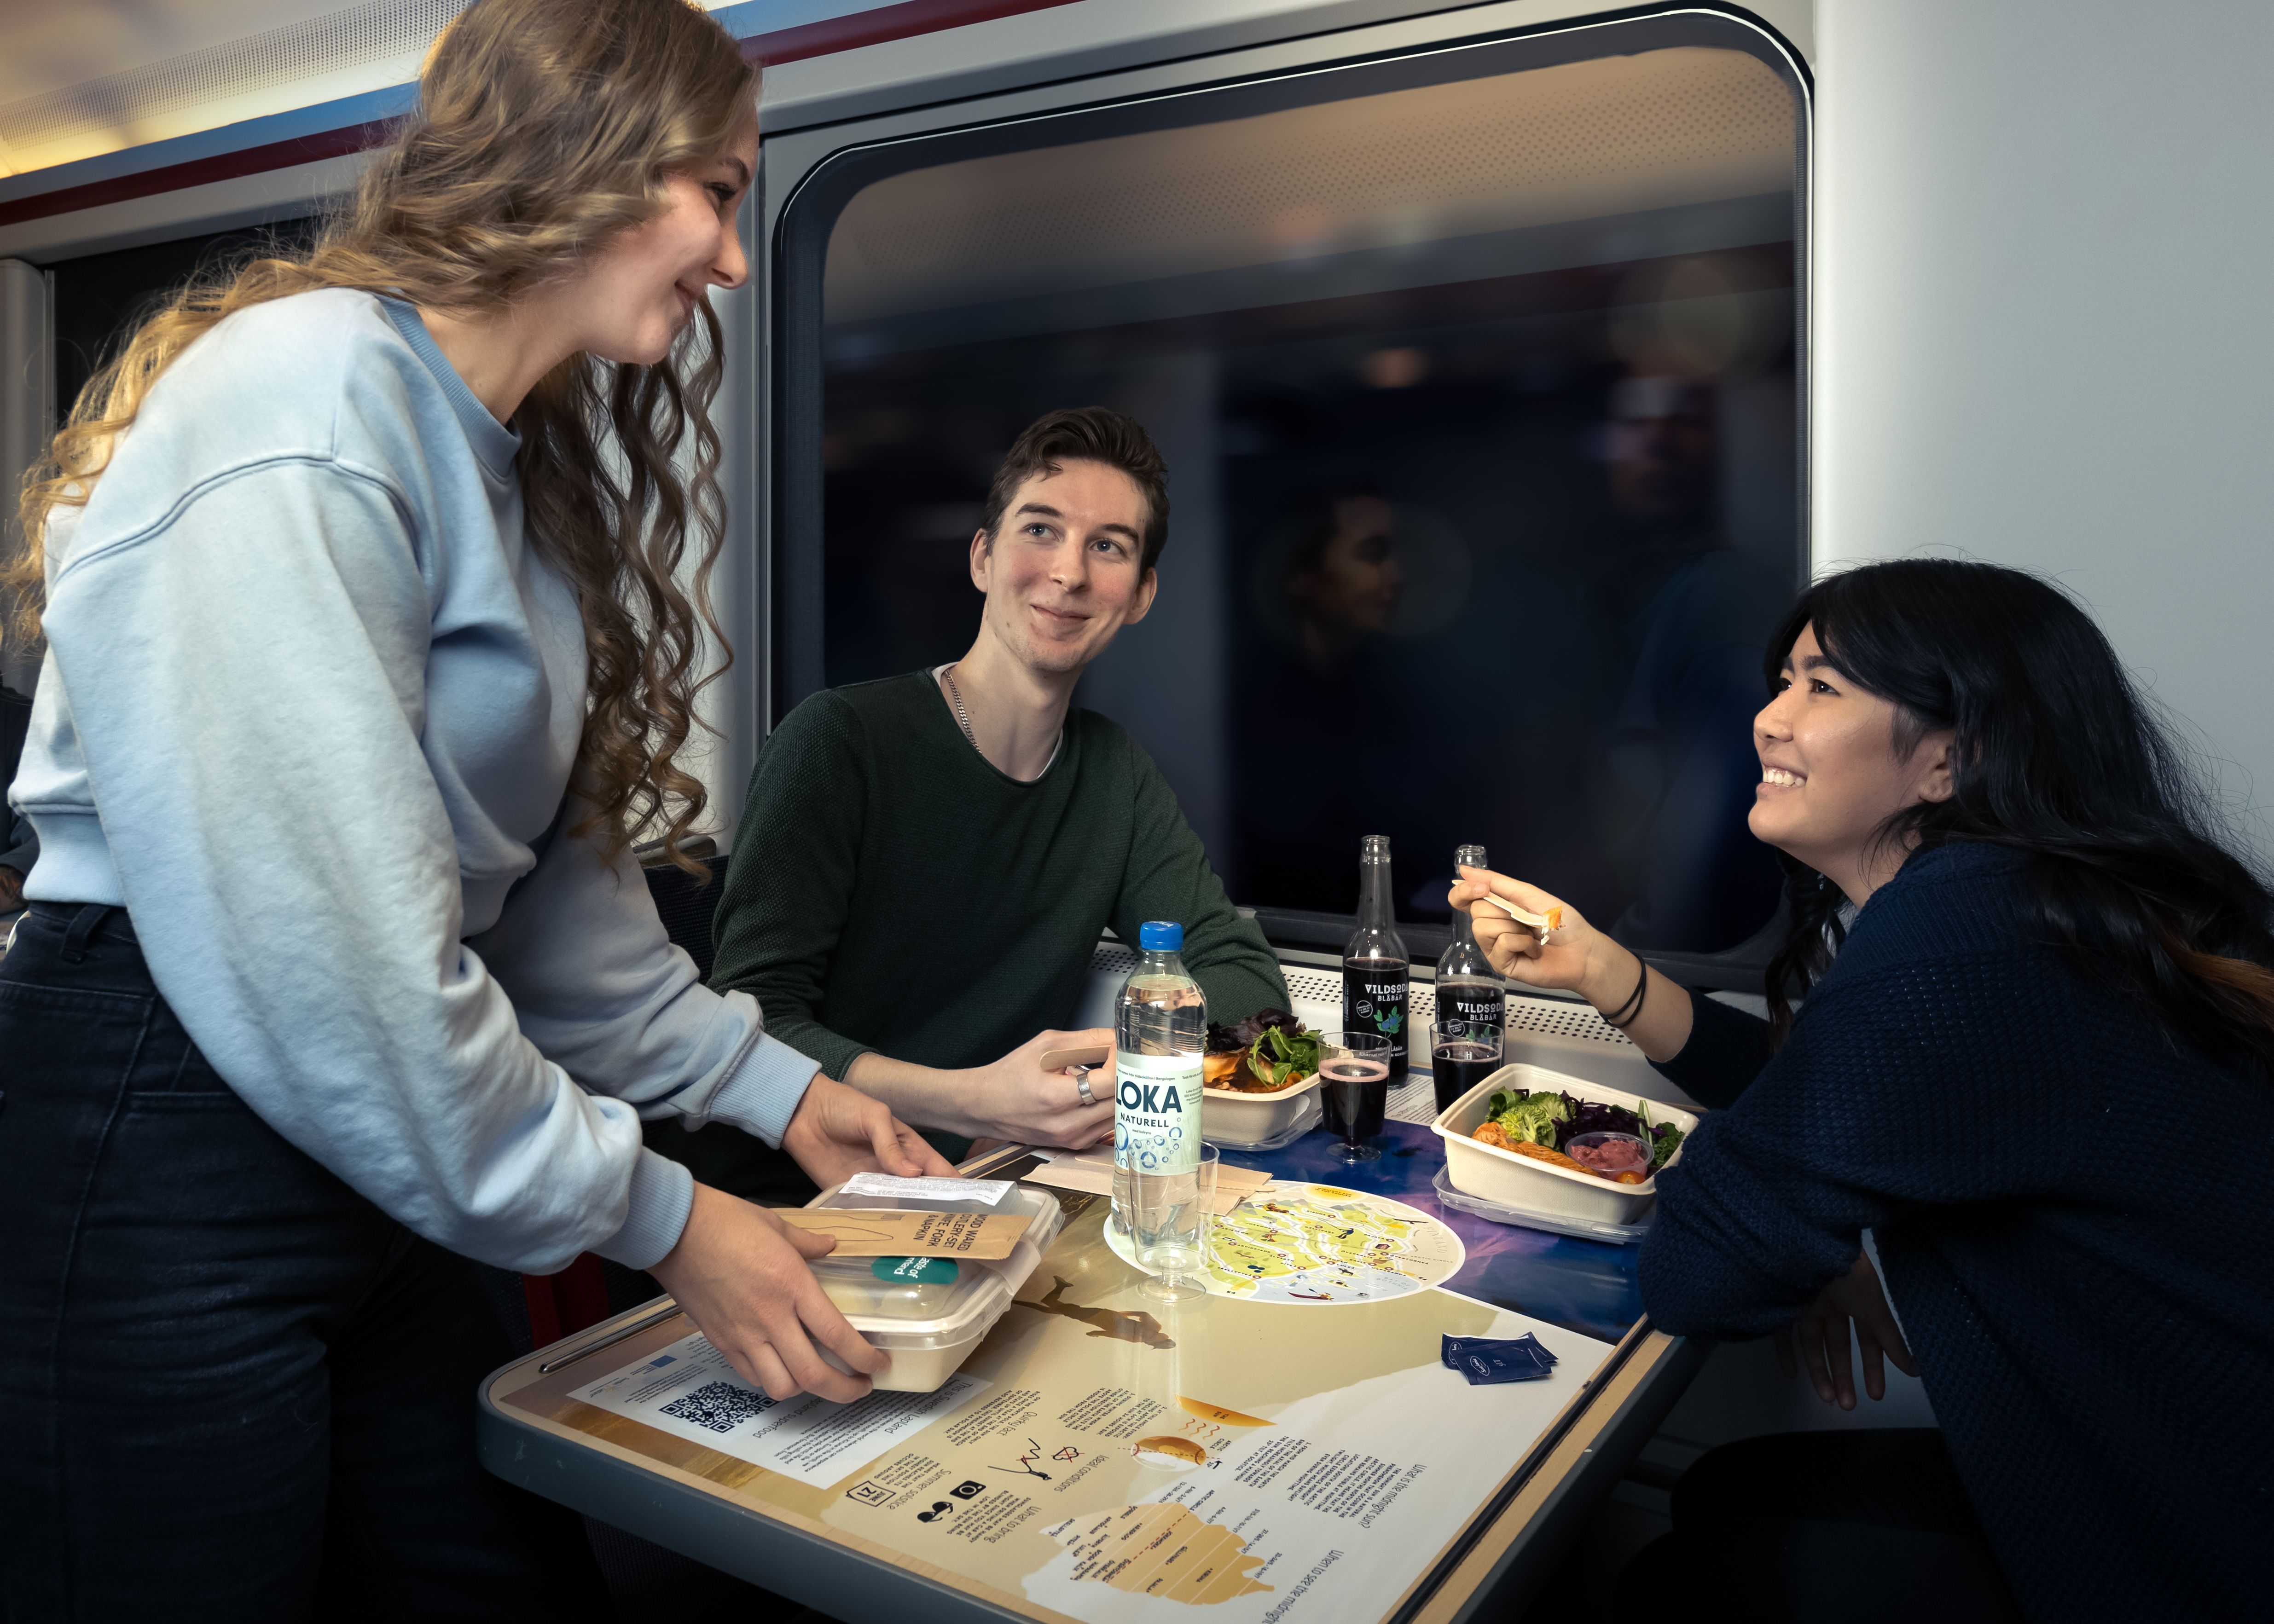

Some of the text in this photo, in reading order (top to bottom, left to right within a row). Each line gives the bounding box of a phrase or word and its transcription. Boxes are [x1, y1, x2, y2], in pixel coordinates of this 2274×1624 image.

[1365, 982, 1408, 994] VILDSODA
[1456, 1002, 1504, 1013] VILDSODA
[1116, 1075, 1182, 1114] LOKA
[1120, 1112, 1169, 1127] NATURELL
[970, 1214, 988, 1228] WOOD
[913, 1219, 936, 1240] NAPKIN
[943, 1214, 972, 1248] CUTLERY-SET
[927, 1229, 946, 1247] FORK
[957, 1230, 979, 1250] WAXED
[1423, 1227, 1447, 1253] FINLAND
[1237, 1244, 1271, 1254] ARVIDSJAUR
[893, 1257, 915, 1275] rrland
[907, 1257, 931, 1278] aste of
[1218, 1266, 1252, 1277] SKELLEFTEÅ
[1371, 1267, 1406, 1277] HAPARANDA
[951, 1382, 973, 1392] This
[914, 1394, 950, 1415] Swedish
[1010, 1406, 1026, 1416] NORTH
[752, 1395, 829, 1439] apland superfood
[884, 1414, 920, 1434] Lapland
[996, 1411, 1038, 1436] Quirky fact
[968, 1435, 981, 1444] ONLY
[1209, 1438, 1224, 1449] CIRCLE
[1217, 1439, 1231, 1451] ARCTIC
[874, 1453, 914, 1479] OCCURS AROUND
[923, 1462, 940, 1474] MEANS
[1340, 1454, 1360, 1471] LOCATIONS
[1349, 1462, 1366, 1476] REMAINS
[1365, 1458, 1379, 1470] ARCTIC
[1369, 1462, 1386, 1476] SUMMER
[885, 1456, 929, 1485] HIGHEST POSITION
[902, 1466, 924, 1480] REACHES
[911, 1473, 925, 1482] THAT
[1053, 1454, 1109, 1492] Ideal conditions
[1287, 1453, 1330, 1491] EVEN DURING NIGHTTIME.
[1288, 1449, 1346, 1501] TWILIGHT, WHICH MEANS DAYLIGHT
[1299, 1454, 1350, 1500] CIRCLE EXPERIENCE MIDNIGHT
[1328, 1470, 1343, 1482] SOUTH
[1352, 1470, 1368, 1482] CIRCLE.
[1372, 1462, 1396, 1485] PHENOMENON
[1404, 1463, 1427, 1479] What
[886, 1468, 951, 1510] Summer solstice
[1337, 1475, 1352, 1488] VISIBLE
[1356, 1475, 1373, 1489] MONTHS
[1363, 1484, 1375, 1493] THAT
[1377, 1474, 1395, 1490] MIDNIGHT
[1391, 1482, 1408, 1492] the
[856, 1486, 877, 1497] 21
[868, 1491, 886, 1502] JUNE
[1338, 1485, 1352, 1497] MEANS
[1345, 1489, 1359, 1501] NORTH
[1189, 1489, 1215, 1511] ARCTIC CIRCLE
[1303, 1492, 1318, 1506] ARCTIC
[1313, 1491, 1335, 1510] NIGHTTIME.
[1329, 1497, 1341, 1506] THAT
[1349, 1493, 1366, 1507] OCCURS
[1369, 1490, 1398, 1515] midnight
[1014, 1506, 1042, 1522] What
[1349, 1503, 1366, 1518] NATURAL
[1357, 1513, 1375, 1528] sun?
[983, 1526, 1013, 1543] bring
[1261, 1549, 1344, 1624] When to see the midnight
